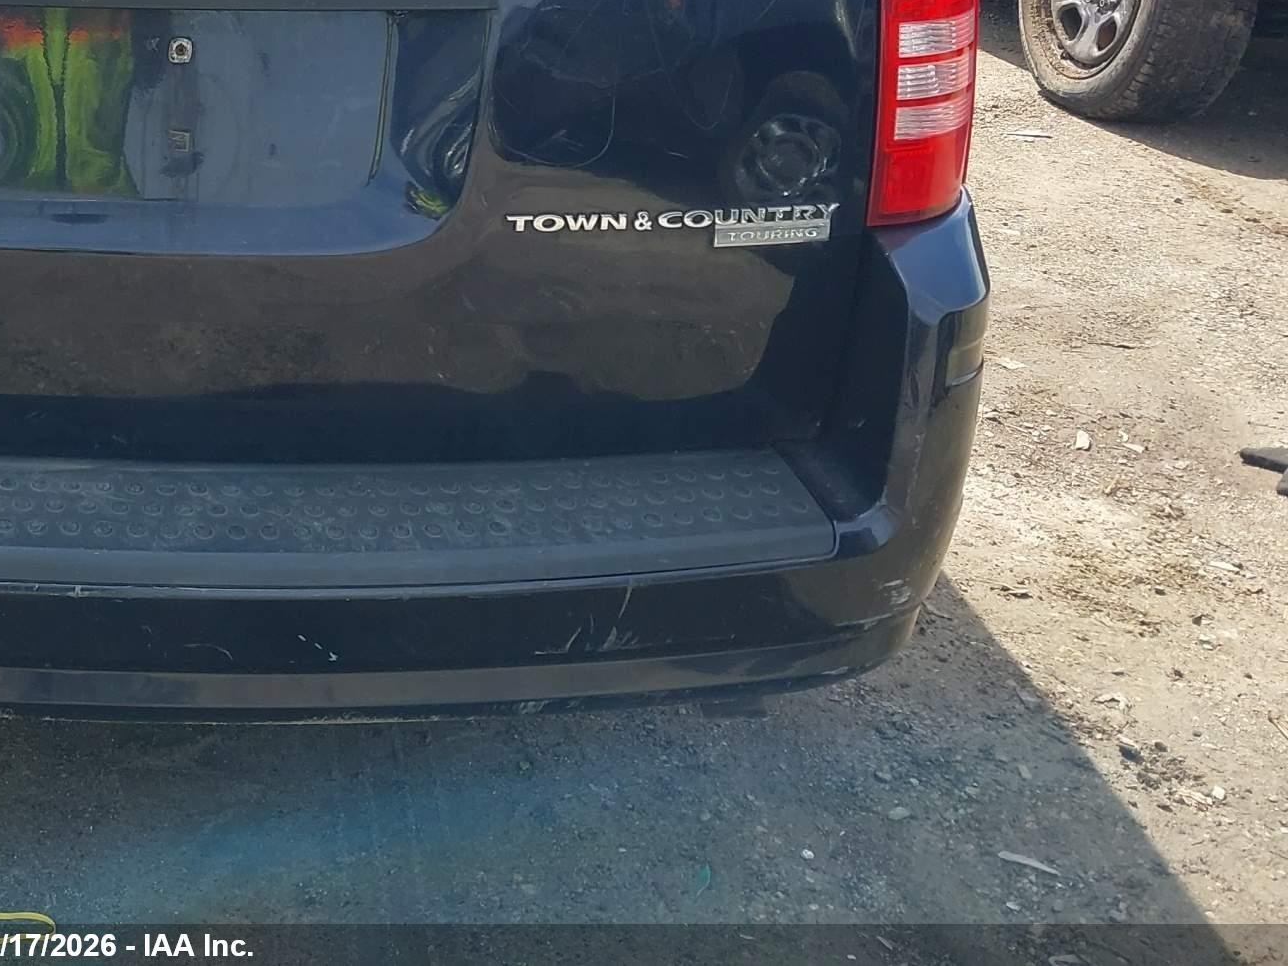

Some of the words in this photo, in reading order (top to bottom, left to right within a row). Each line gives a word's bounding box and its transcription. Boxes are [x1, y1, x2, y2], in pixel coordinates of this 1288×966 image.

[506, 213, 627, 232] TOWN
[634, 211, 653, 231] &
[657, 202, 840, 229] COUNTRY
[727, 227, 818, 242] TOURING
